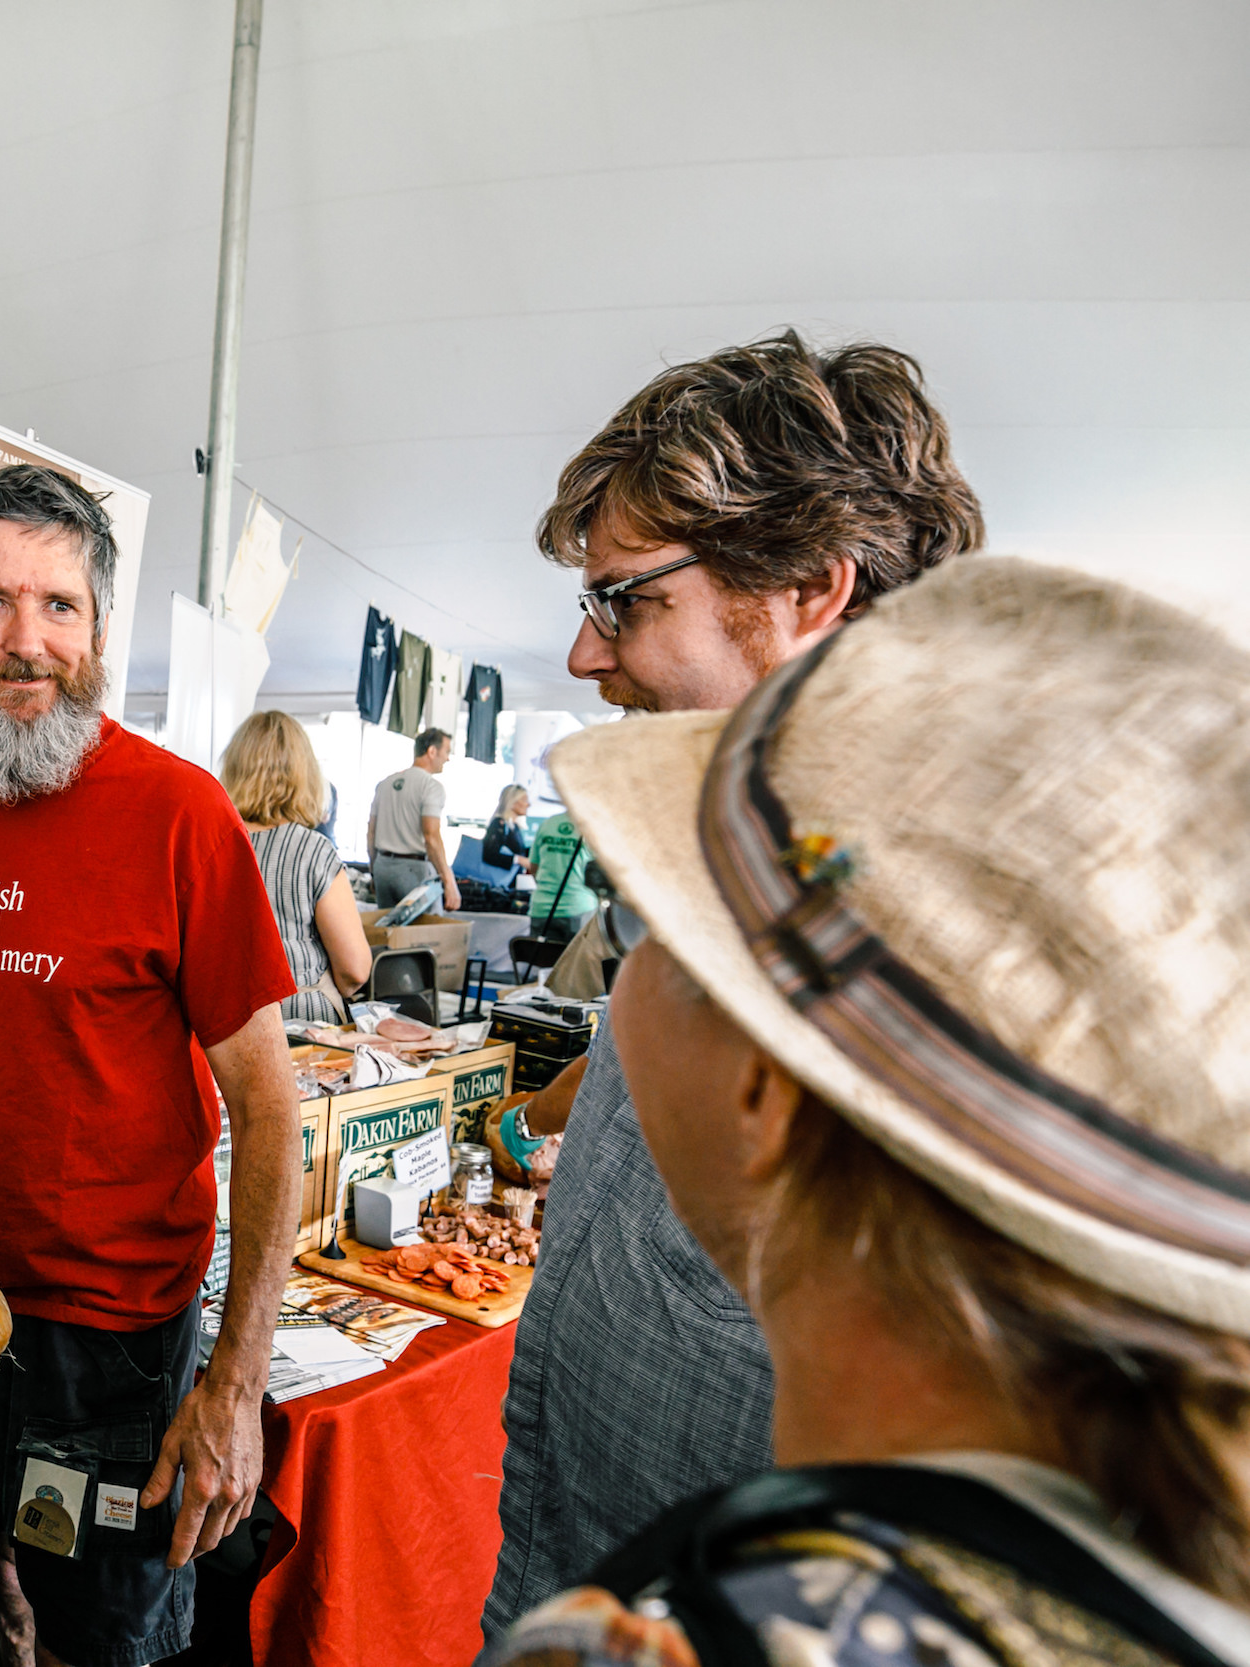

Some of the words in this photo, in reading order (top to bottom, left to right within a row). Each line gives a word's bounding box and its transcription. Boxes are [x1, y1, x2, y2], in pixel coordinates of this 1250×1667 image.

[453, 1080, 470, 1104] KIN
[470, 1072, 502, 1099] FARM
[348, 1117, 398, 1151] DAKIN
[396, 1107, 438, 1139] FARM
